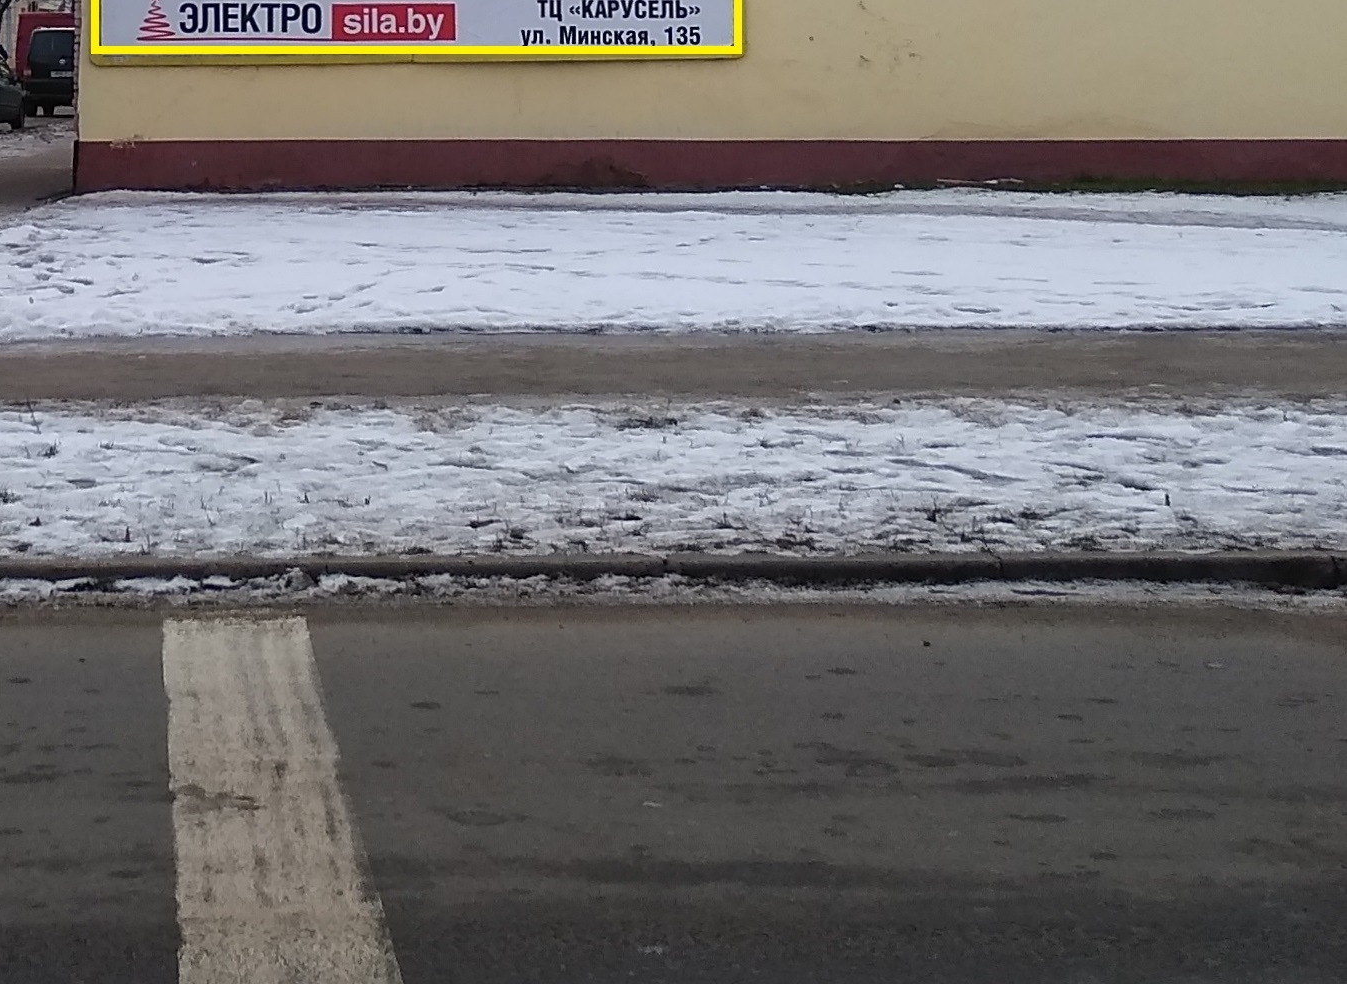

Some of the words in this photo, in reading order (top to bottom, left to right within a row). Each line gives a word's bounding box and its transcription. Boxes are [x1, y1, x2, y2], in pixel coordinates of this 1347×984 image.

[179, 3, 322, 34] ЭЛЕКТРО
[343, 8, 445, 39] sila.by
[537, 0, 563, 22] ТЦ
[569, 0, 701, 19] «КАРУСЕЛЬ»
[520, 29, 551, 46] ул.
[559, 26, 656, 46] Минская,
[664, 26, 701, 46] 135
